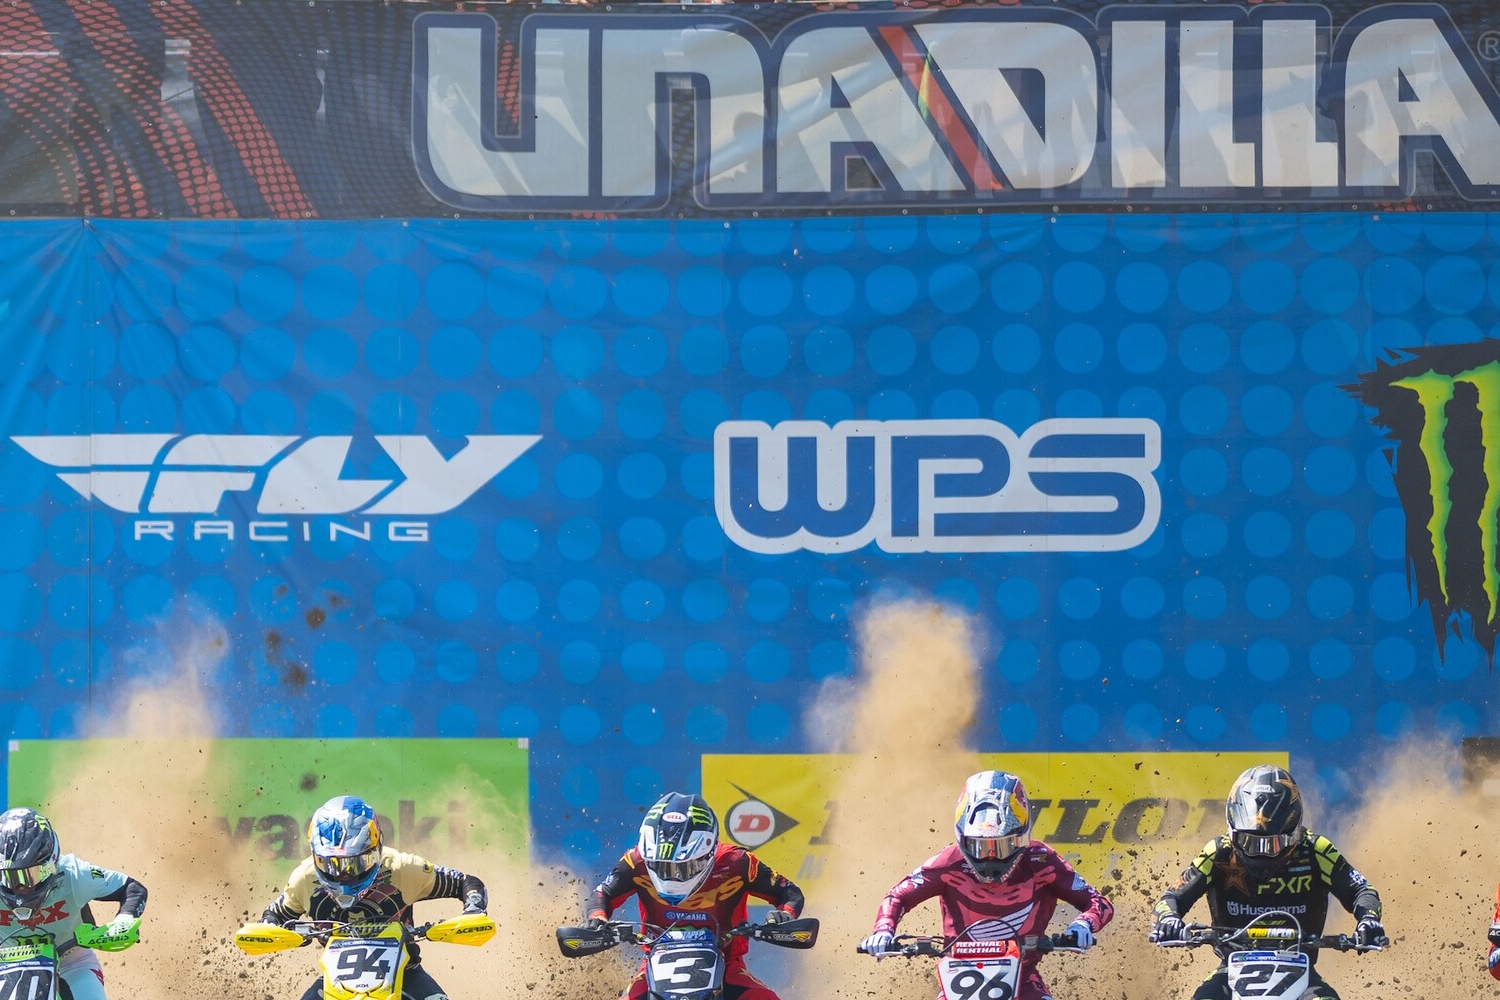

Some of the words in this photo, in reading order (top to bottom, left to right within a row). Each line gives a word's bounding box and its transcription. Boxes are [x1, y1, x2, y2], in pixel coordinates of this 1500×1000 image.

[427, 20, 1500, 194] UNADILLA
[9, 434, 543, 514] FLY
[728, 434, 1147, 540] WPS
[134, 521, 429, 542] RACING
[1258, 874, 1313, 895] FXR
[675, 912, 707, 921] YAMAHA
[1240, 904, 1307, 917] Husqvarna
[88, 934, 130, 945] ACERBIS
[238, 936, 274, 944] ACERBIS
[455, 925, 493, 935] ACERBIS
[336, 949, 391, 981] 94
[654, 950, 717, 990] 3
[1233, 963, 1306, 997] 27
